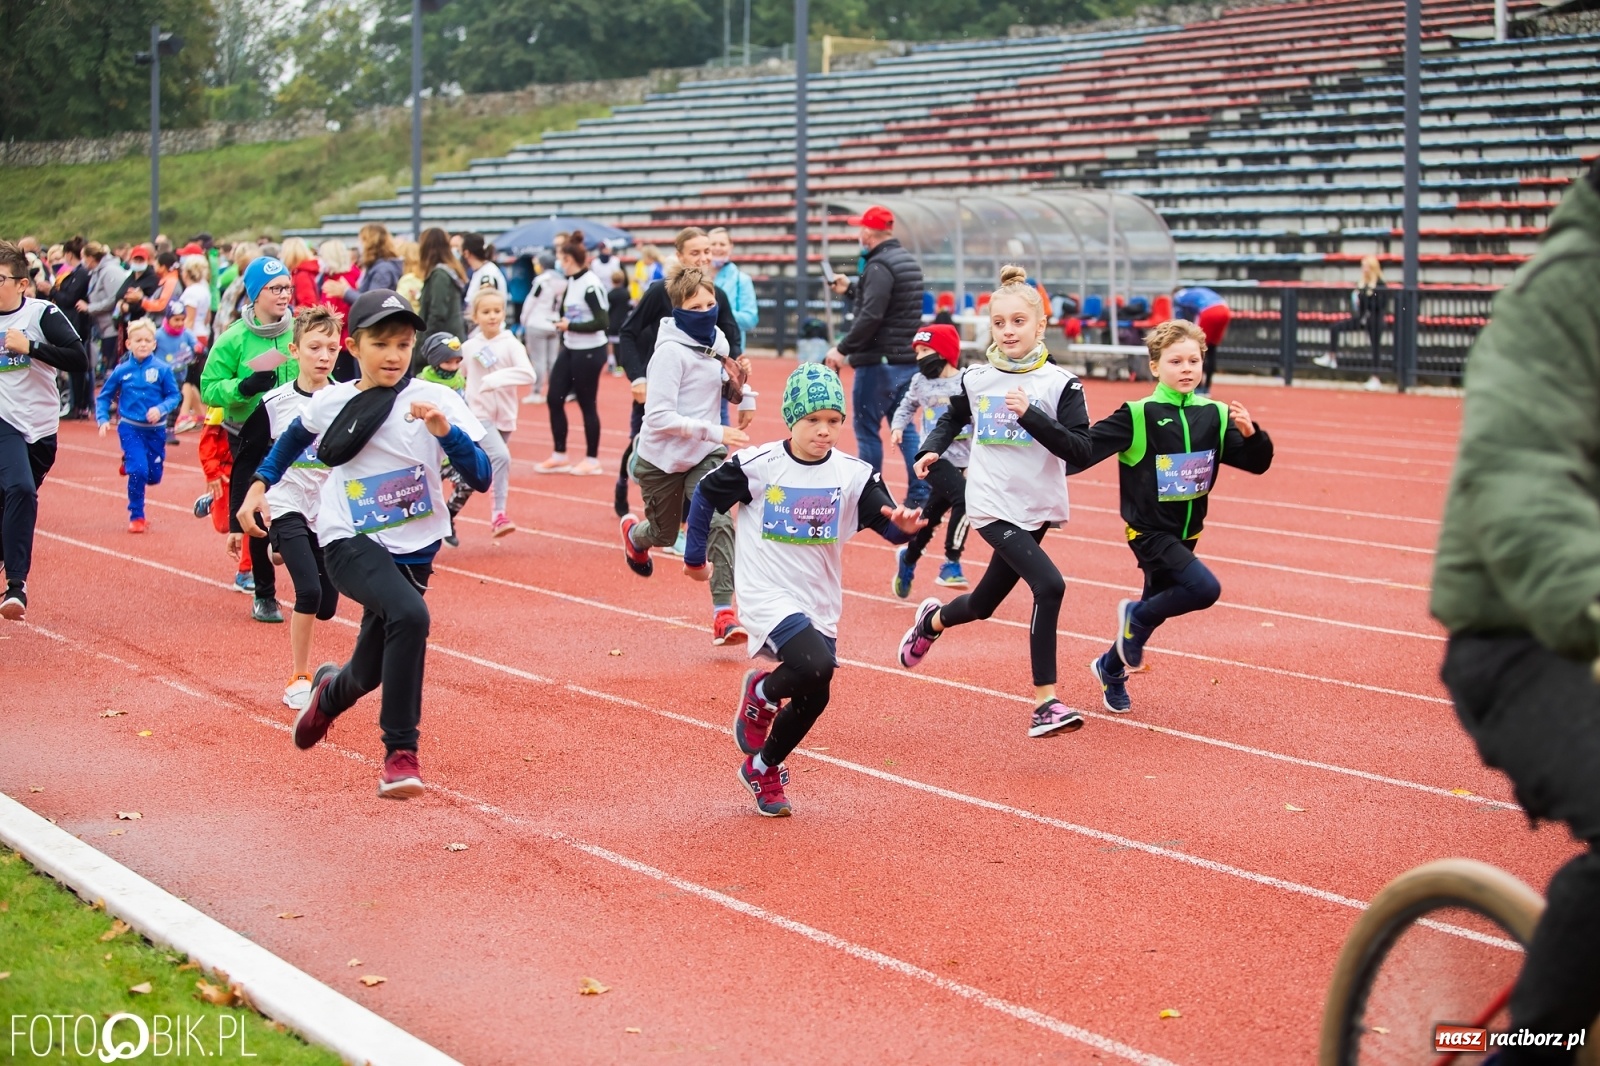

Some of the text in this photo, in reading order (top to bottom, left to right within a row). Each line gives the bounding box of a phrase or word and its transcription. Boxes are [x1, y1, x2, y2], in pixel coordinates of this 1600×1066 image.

[8, 354, 25, 366] 286
[1004, 429, 1027, 441] 096
[1181, 469, 1192, 477] DLA
[358, 497, 375, 507] BIEG
[378, 493, 393, 503] DLA
[401, 502, 427, 518] 160
[774, 505, 790, 514] BIEG
[794, 507, 807, 515] DLA
[808, 525, 832, 539] 058
